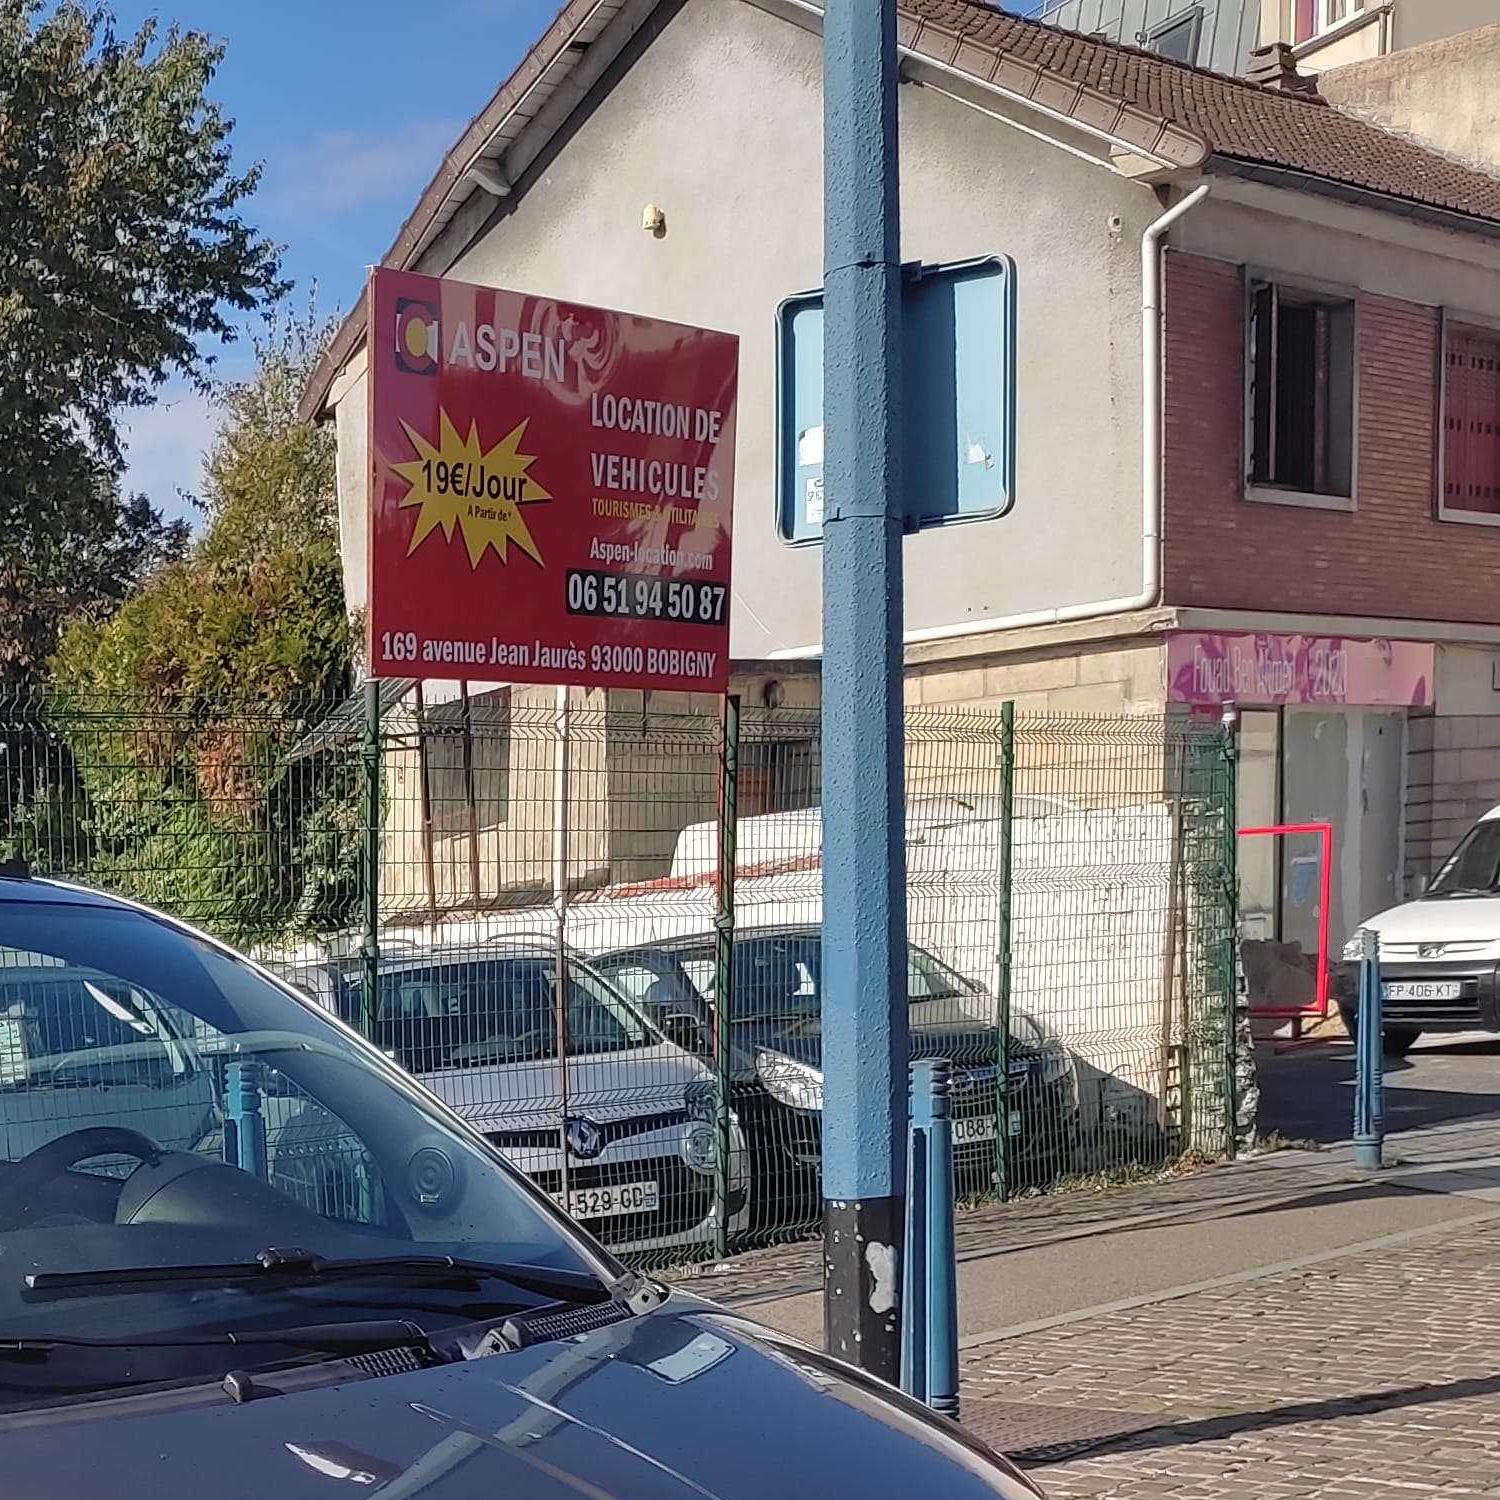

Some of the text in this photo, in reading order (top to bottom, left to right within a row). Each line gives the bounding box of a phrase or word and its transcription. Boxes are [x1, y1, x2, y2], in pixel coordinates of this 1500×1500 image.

[449, 321, 565, 383] ASPEN
[591, 392, 721, 444] LOCATION DE
[422, 459, 527, 501] 19€/Jour
[590, 453, 719, 501] VEHICULES
[475, 505, 497, 520] Partir
[591, 498, 652, 521] TOURISMES
[590, 537, 713, 570] Aspen-location.com
[568, 573, 726, 621] 06 51 94 50 87
[381, 631, 717, 679] 169 avenue Jean Jaurès 93000 BOBIGNY
[1193, 645, 1230, 694] Fouad
[1256, 648, 1295, 695] Ahmed
[1315, 649, 1347, 696] 2020
